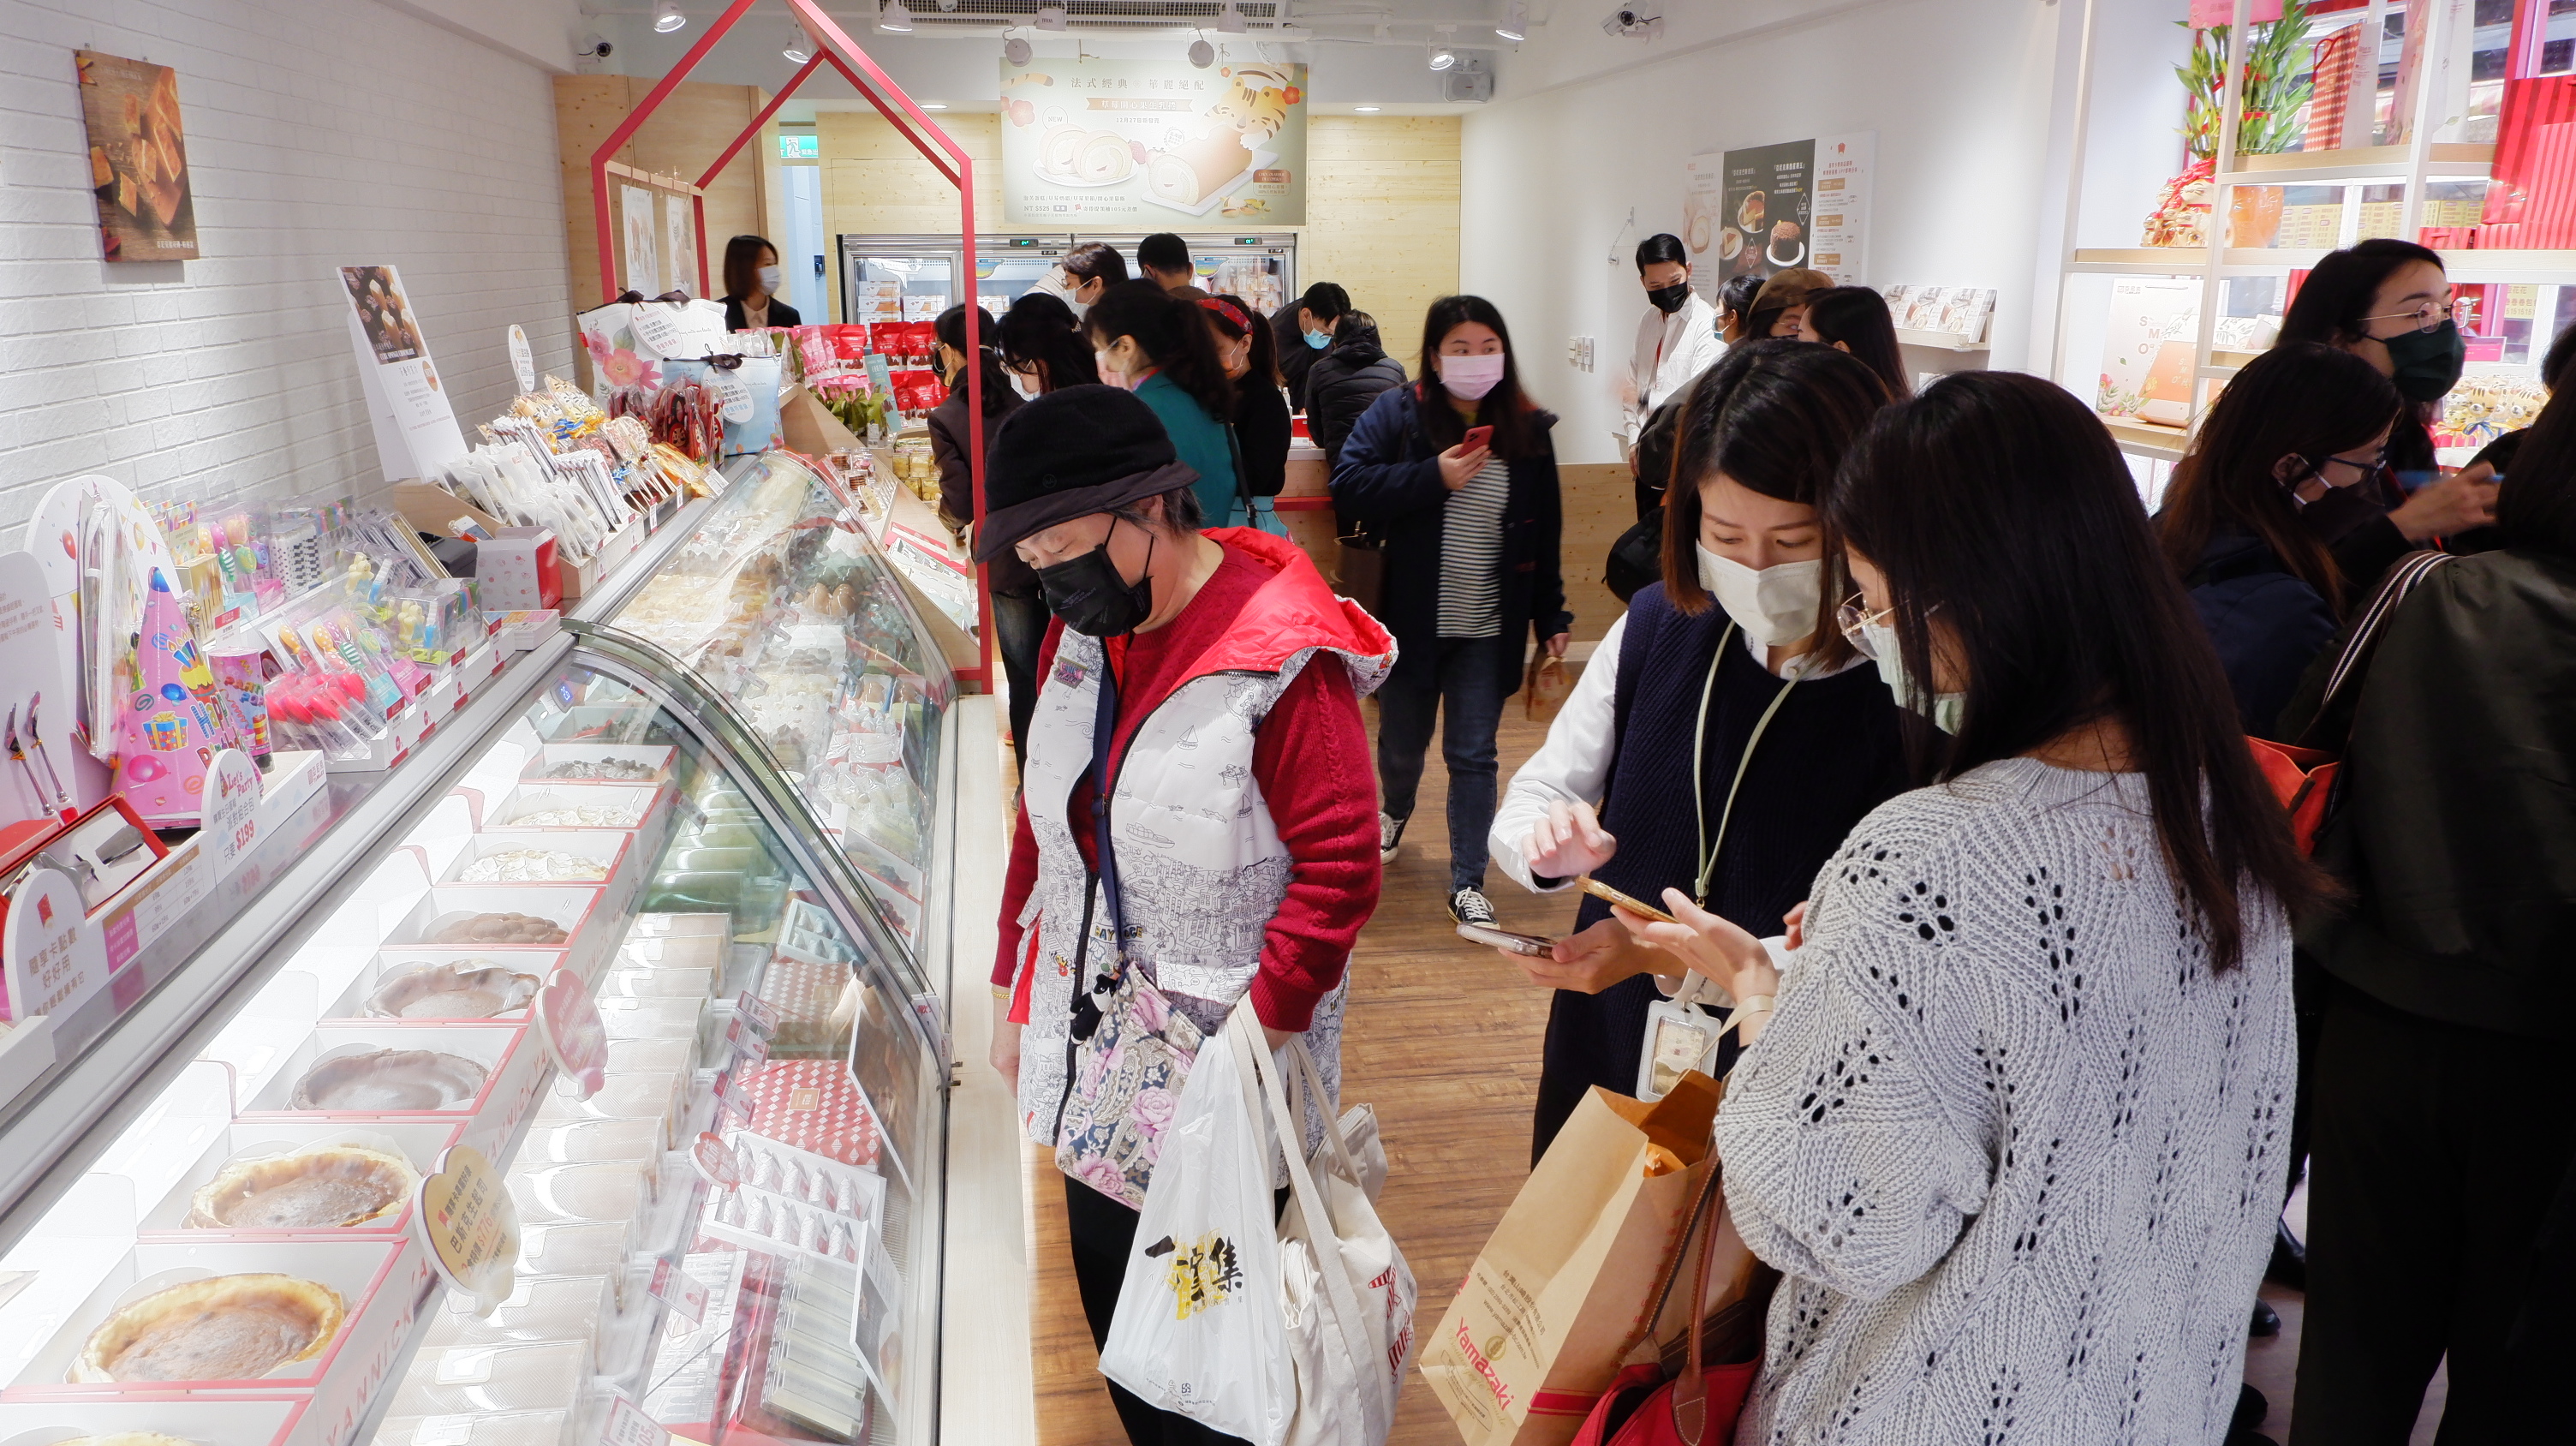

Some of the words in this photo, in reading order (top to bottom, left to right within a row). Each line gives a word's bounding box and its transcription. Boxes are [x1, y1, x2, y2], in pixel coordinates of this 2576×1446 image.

[1070, 77, 1128, 89] 法式經典
[1149, 79, 1205, 91] 華麗絕配
[227, 769, 243, 792] Let's
[237, 776, 254, 798] Party
[227, 797, 255, 832] 派對組合包
[224, 841, 236, 864] 只要
[236, 819, 255, 851] $199
[1094, 925, 1115, 942] BAY
[28, 926, 77, 977] 隨享卡點數
[42, 954, 71, 990] 好好用
[450, 1177, 488, 1254] 巴斯克生起司
[477, 1212, 493, 1247] $776
[1502, 1270, 1547, 1336] 台灣山崎股份有限公司
[1456, 1317, 1515, 1412] Yamazaki
